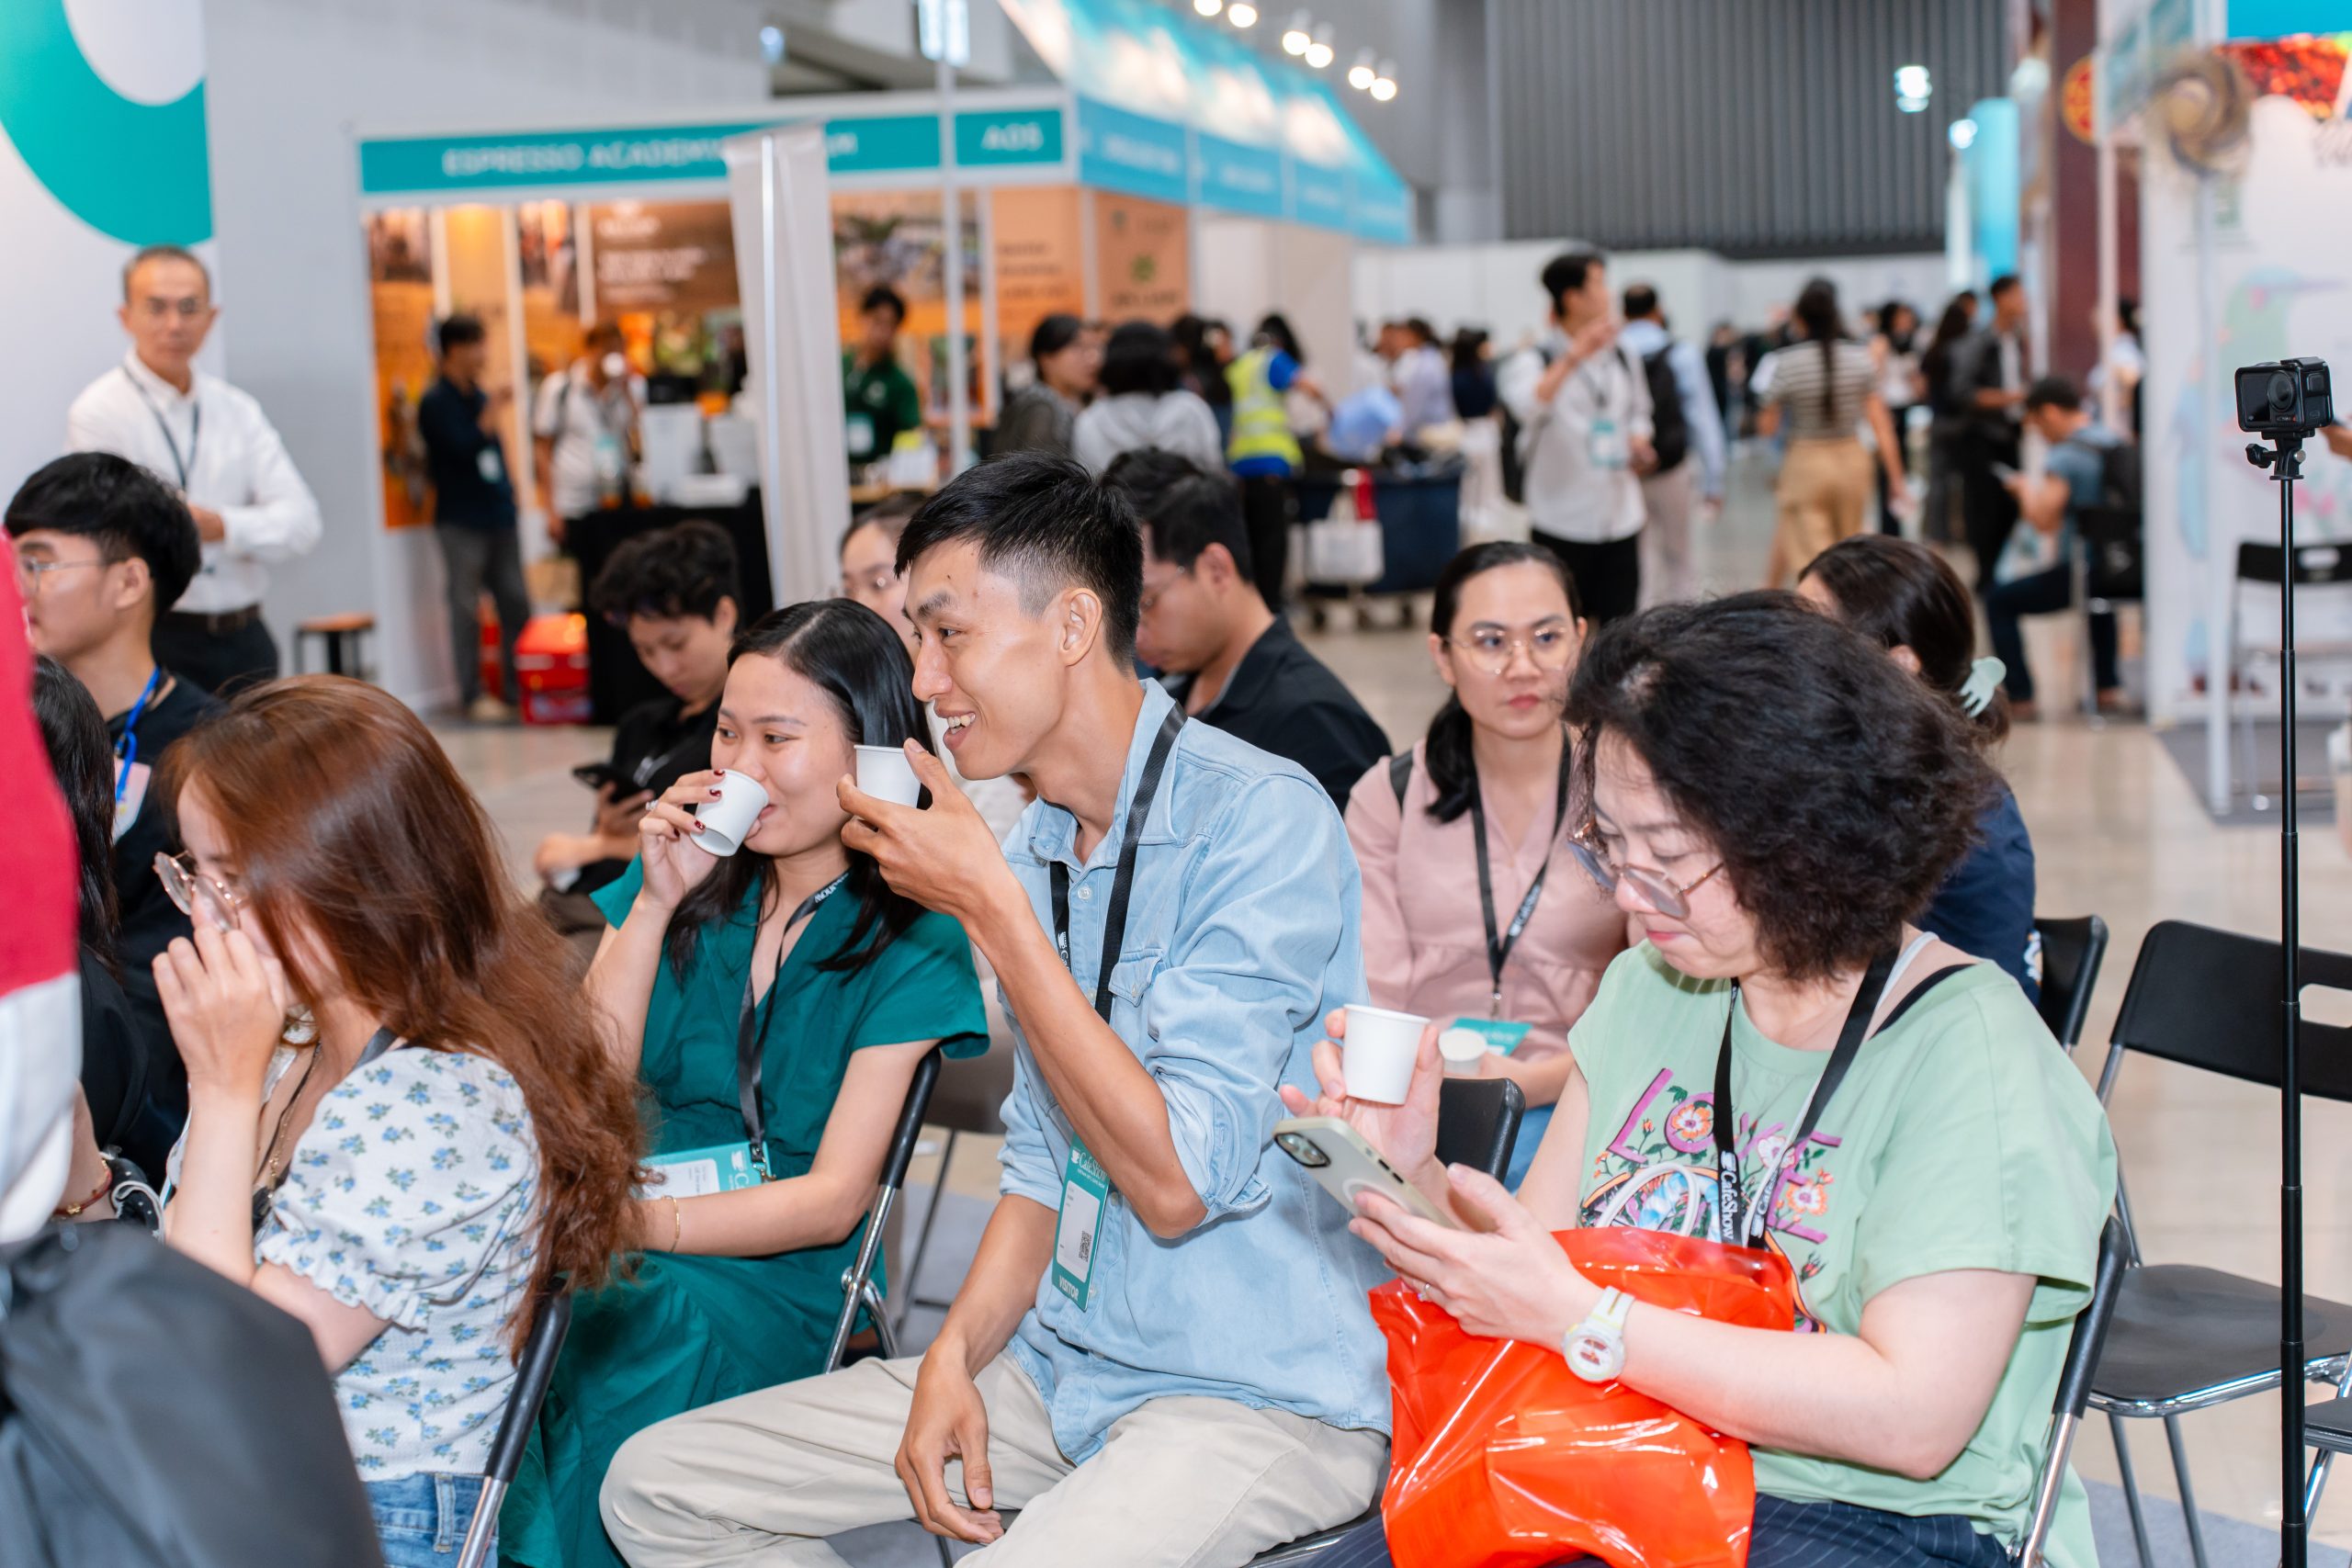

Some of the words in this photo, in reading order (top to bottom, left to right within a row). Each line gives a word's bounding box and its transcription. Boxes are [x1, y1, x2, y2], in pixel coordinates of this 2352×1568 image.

[444, 145, 582, 175] ESPRESSO
[1721, 1170, 1738, 1240] CafeShow
[1058, 1274, 1080, 1302] VISITOR
